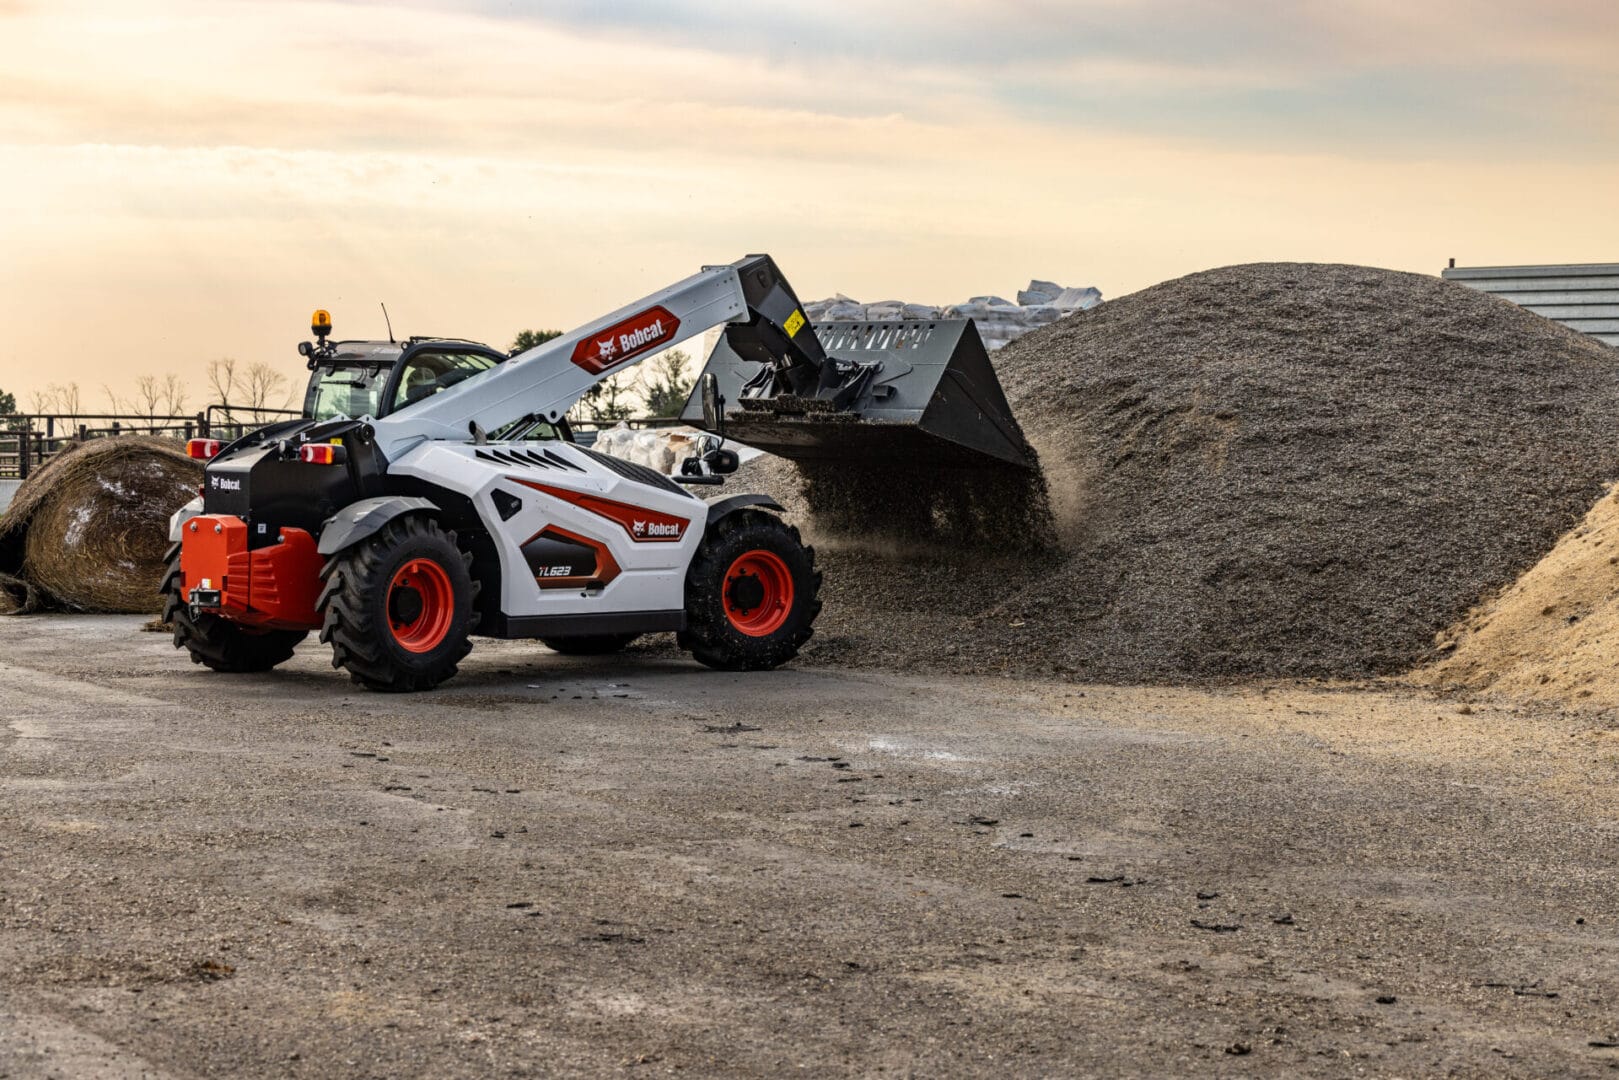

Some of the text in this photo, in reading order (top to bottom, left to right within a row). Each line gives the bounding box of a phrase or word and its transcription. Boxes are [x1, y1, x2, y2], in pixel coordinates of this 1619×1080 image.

[619, 319, 664, 352] Bobcat
[648, 522, 679, 535] Bobcat
[539, 566, 571, 576] TL623
